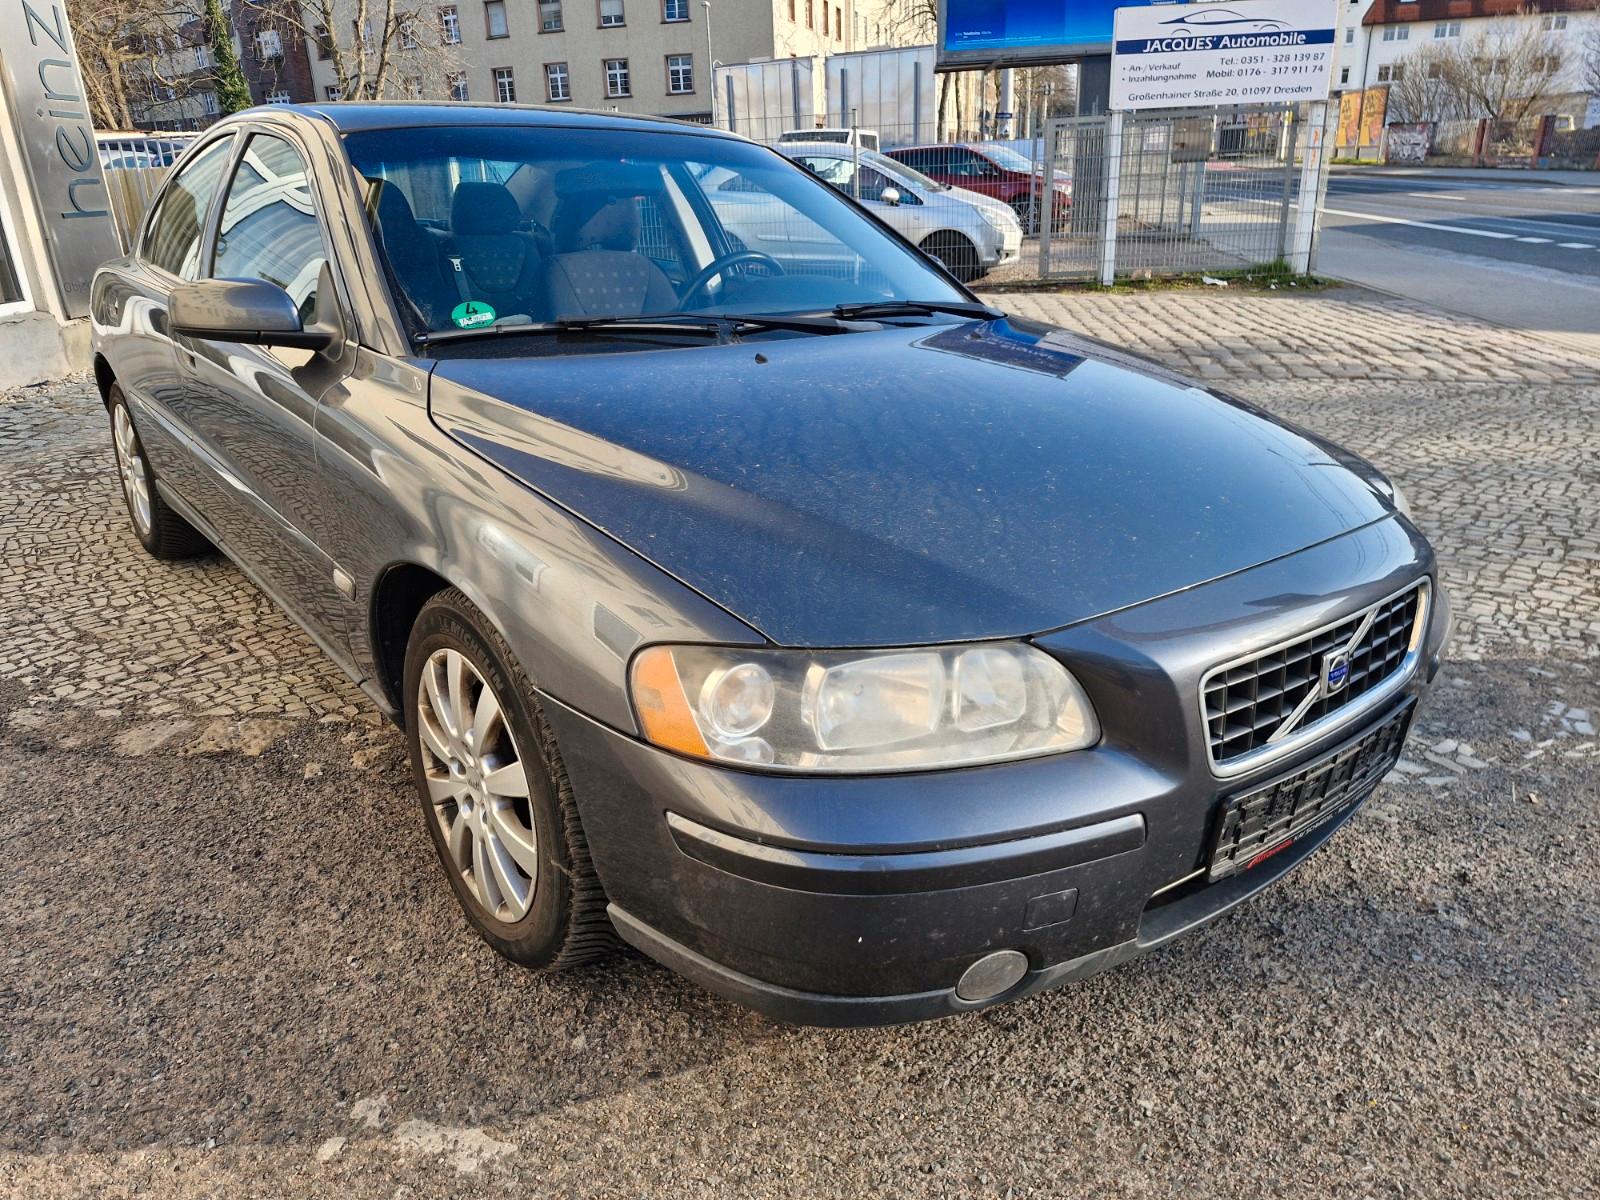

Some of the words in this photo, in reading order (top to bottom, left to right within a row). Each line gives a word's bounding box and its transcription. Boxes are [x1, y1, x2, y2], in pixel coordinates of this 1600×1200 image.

[1142, 38, 1217, 53] JACQUES'
[1218, 33, 1306, 48] Automobile
[1219, 57, 1238, 66] Tel.:
[1240, 55, 1264, 65] 0351
[1273, 54, 1290, 63] 328
[1293, 53, 1311, 62] 139
[1312, 52, 1325, 61] 87
[1128, 73, 1197, 83] Inzahlungnahme
[1206, 69, 1235, 78] Mobil:
[1237, 68, 1261, 77] 0176
[1271, 66, 1289, 75] 317
[1291, 65, 1308, 74] 911
[1311, 64, 1324, 73] 74
[1128, 89, 1191, 102] Großenhainer
[1193, 88, 1223, 98] Straße
[1241, 86, 1271, 96] 01097
[1273, 84, 1312, 94] Dresden
[21, 0, 108, 219] heinz
[466, 302, 478, 314] 4
[450, 621, 504, 690] MICHELIN
